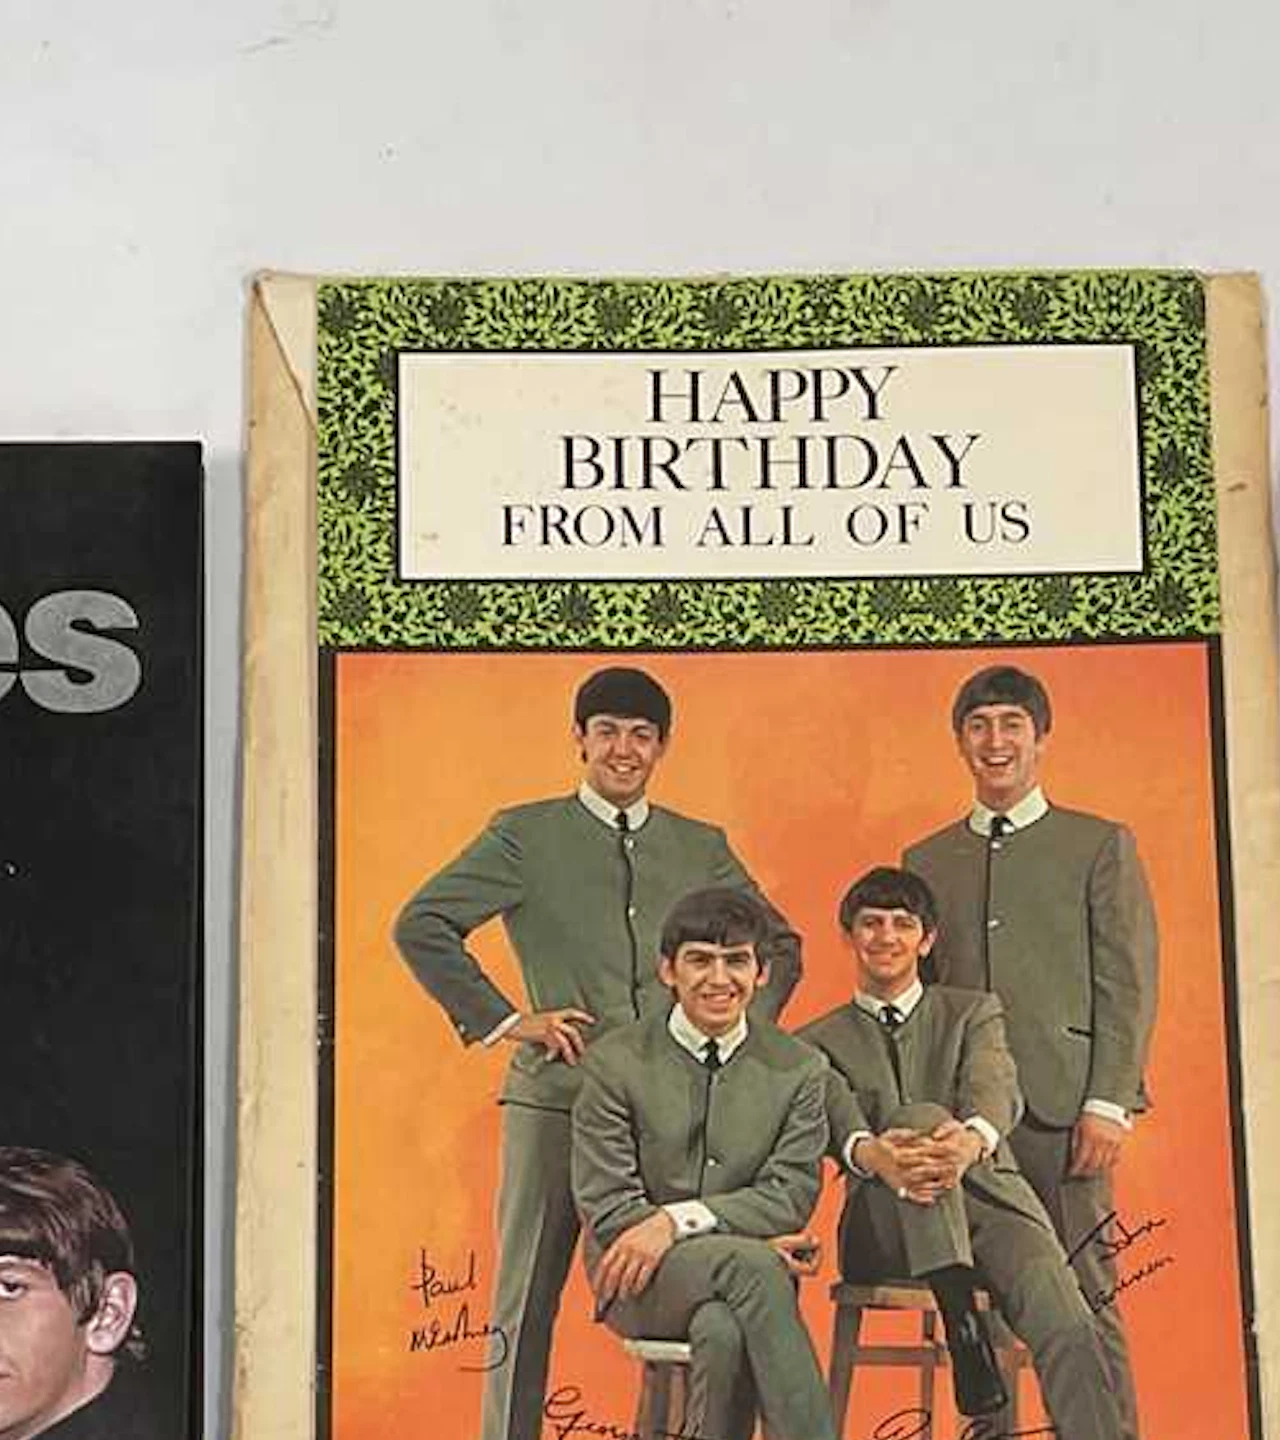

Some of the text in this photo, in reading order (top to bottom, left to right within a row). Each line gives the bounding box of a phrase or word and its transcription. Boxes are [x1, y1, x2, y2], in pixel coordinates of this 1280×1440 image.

[645, 366, 899, 424] HAPPY
[562, 433, 980, 492] BIRTHDAY
[501, 501, 1031, 547] FROM ALL OF US
